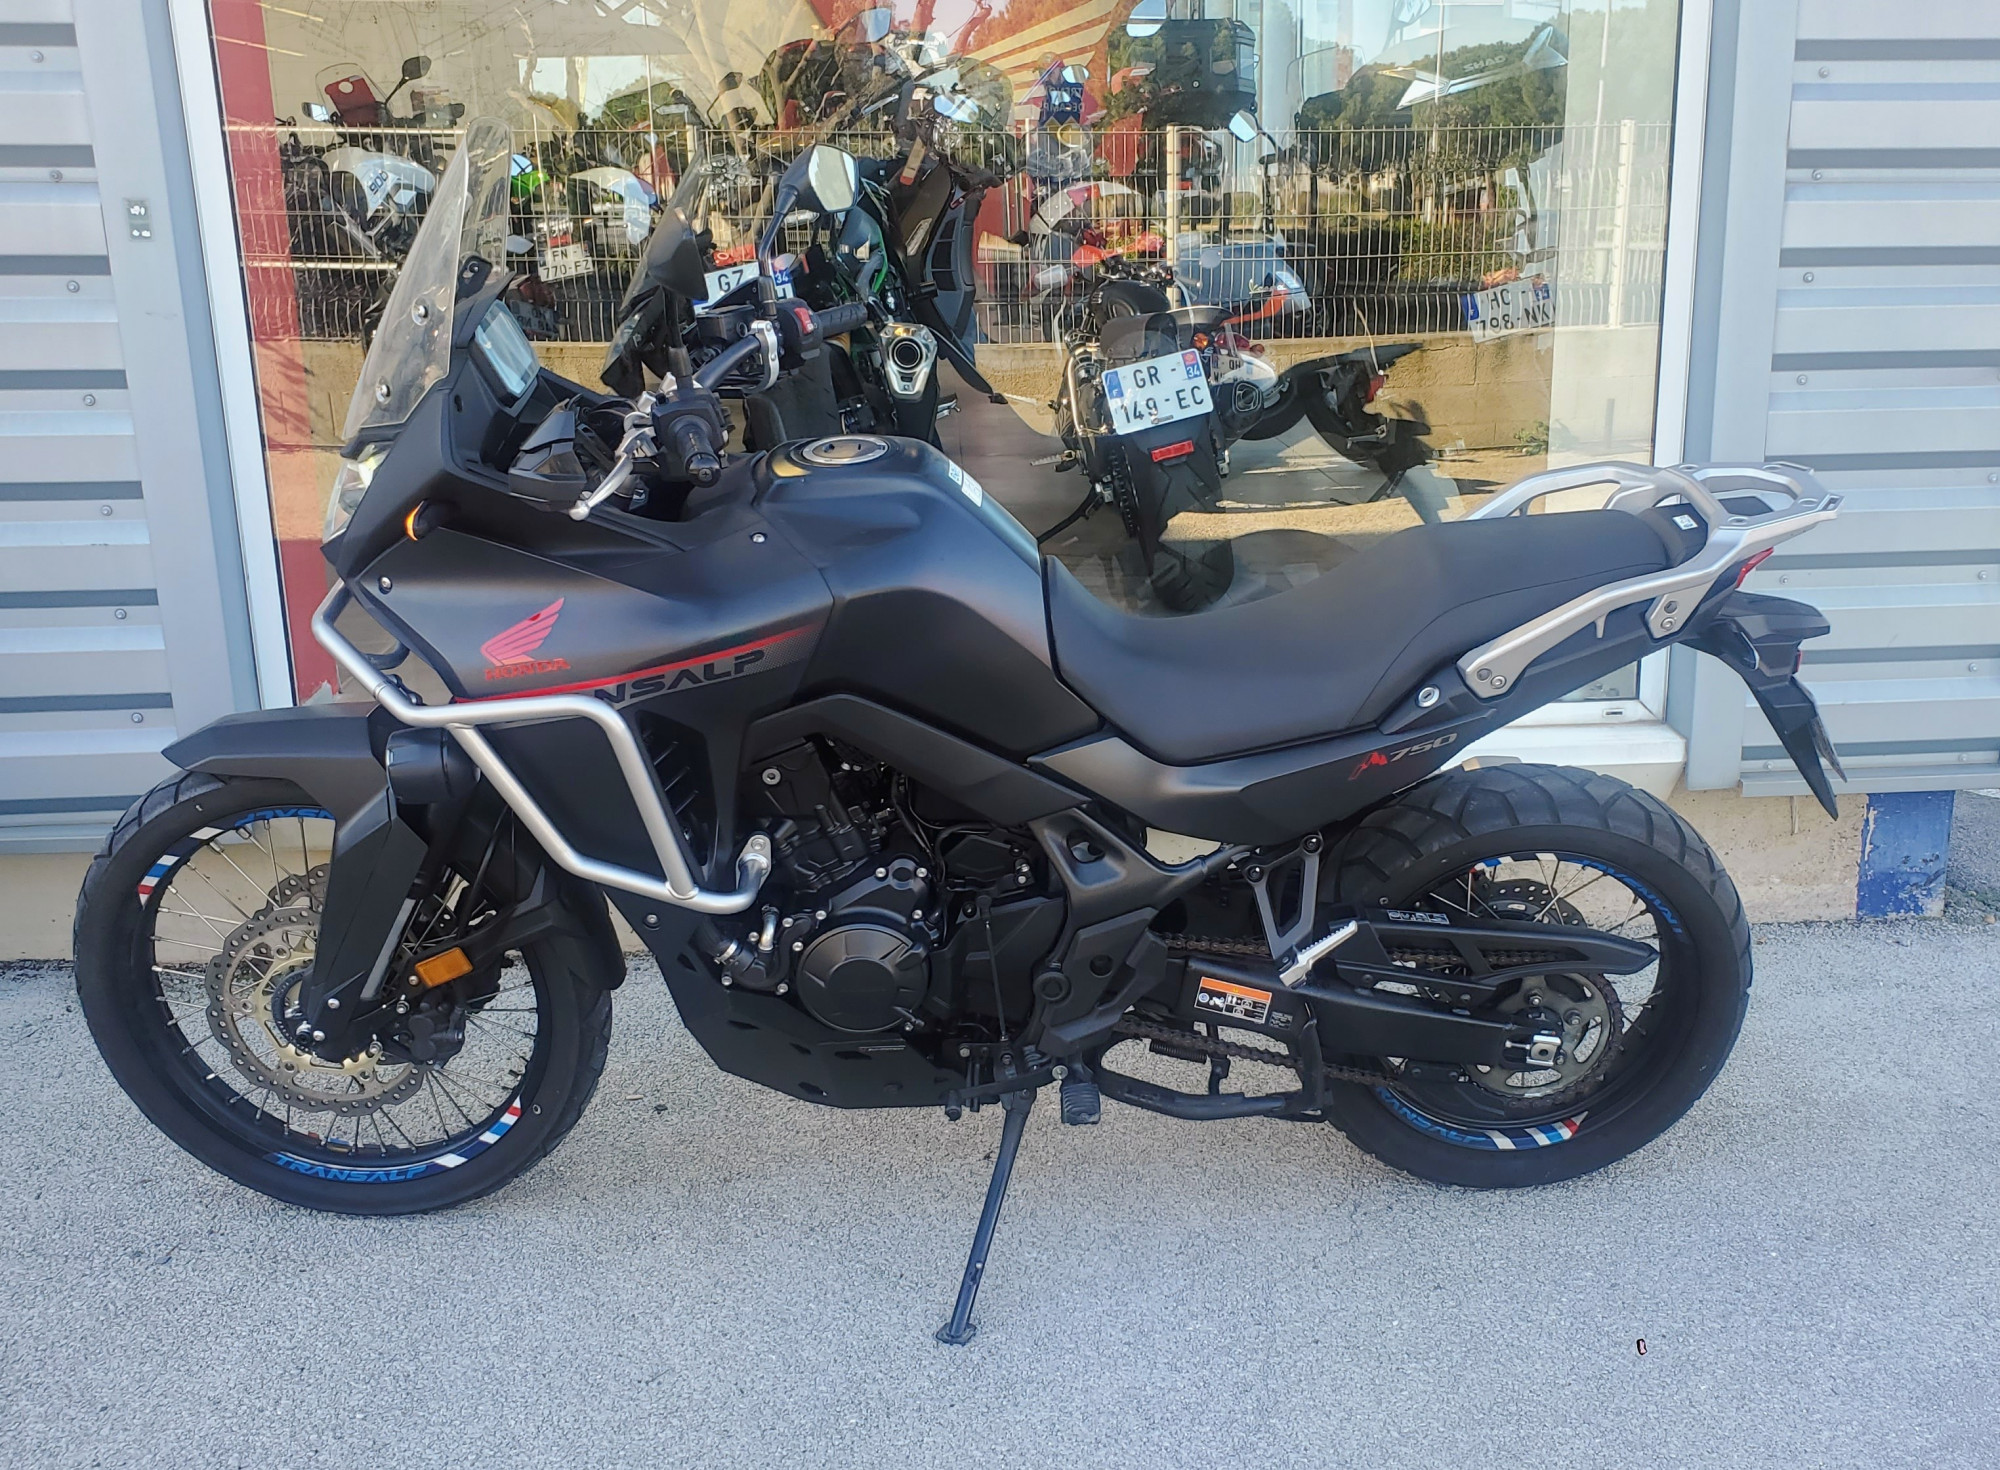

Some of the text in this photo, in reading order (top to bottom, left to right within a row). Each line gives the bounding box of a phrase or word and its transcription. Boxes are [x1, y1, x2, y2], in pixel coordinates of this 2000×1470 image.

[369, 170, 389, 195] 900
[775, 273, 789, 284] 34
[1186, 365, 1201, 379] 34
[484, 657, 572, 681] HONDA
[1390, 732, 1458, 763] 750
[276, 1153, 427, 1182] TRANSALP
